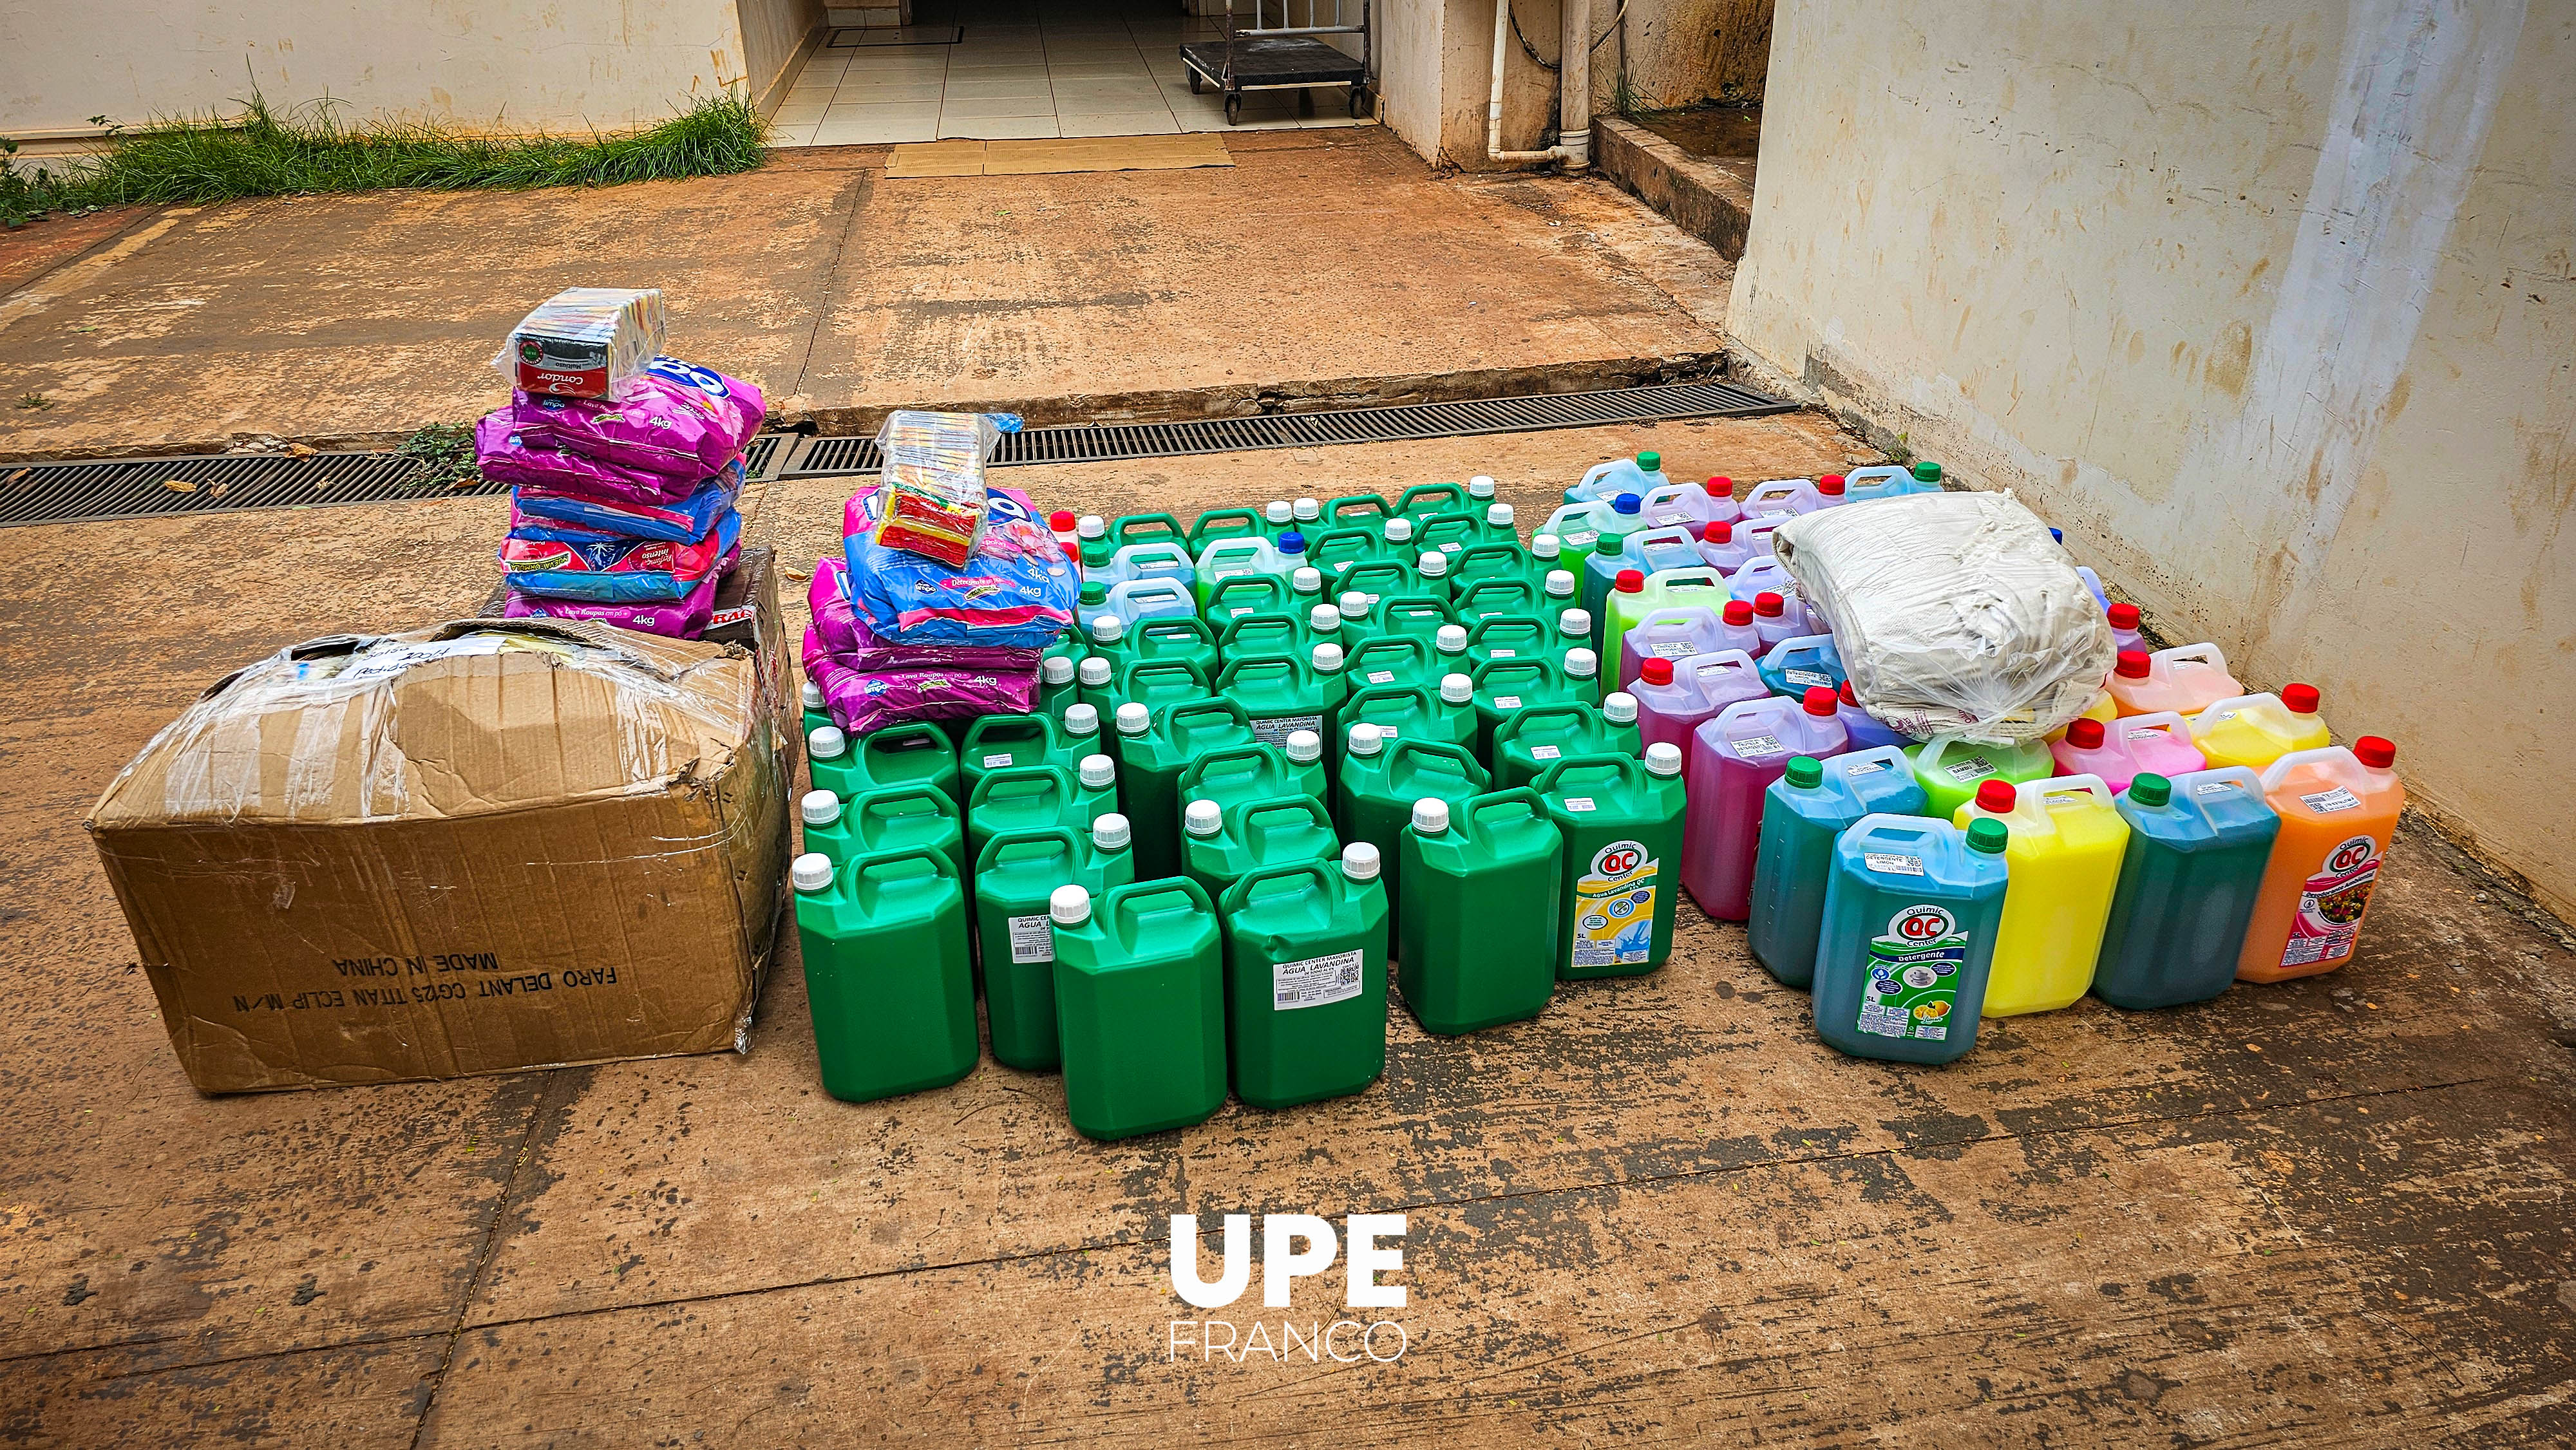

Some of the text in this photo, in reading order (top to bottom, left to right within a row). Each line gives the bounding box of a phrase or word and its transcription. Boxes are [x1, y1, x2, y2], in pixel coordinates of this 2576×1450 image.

[537, 373, 583, 385] Condor
[649, 416, 672, 429] 4kg
[509, 435, 522, 445] lim
[641, 548, 669, 559] intenso
[1019, 585, 1041, 598] 4kg
[581, 608, 605, 617] Roupas
[632, 614, 656, 626] 4kg
[973, 675, 998, 686] 4kg
[1278, 720, 1316, 729] LAVANDINA
[1903, 716, 1921, 734] enter
[1604, 842, 1636, 854] Quimic
[2339, 836, 2369, 850] Quimic
[1604, 852, 1634, 872] QC
[2335, 846, 2365, 869] QC
[1607, 870, 1633, 882] Center
[2335, 865, 2360, 879] Center
[1607, 881, 1636, 895] Lavandina
[1906, 907, 1944, 916] Quimic
[1904, 917, 1940, 937] QC
[1906, 937, 1937, 947] Center
[1305, 956, 1325, 965] CENTER
[1327, 951, 1357, 961] MAYORISTA
[1898, 951, 1945, 962] Detergente
[334, 952, 499, 977] MADE IN CHINA
[1282, 966, 1306, 975] AGUA
[1310, 956, 1354, 971] LAVANDINA
[233, 967, 618, 1013] FARO DELANT CG125 TITAN ECLIP M/N
